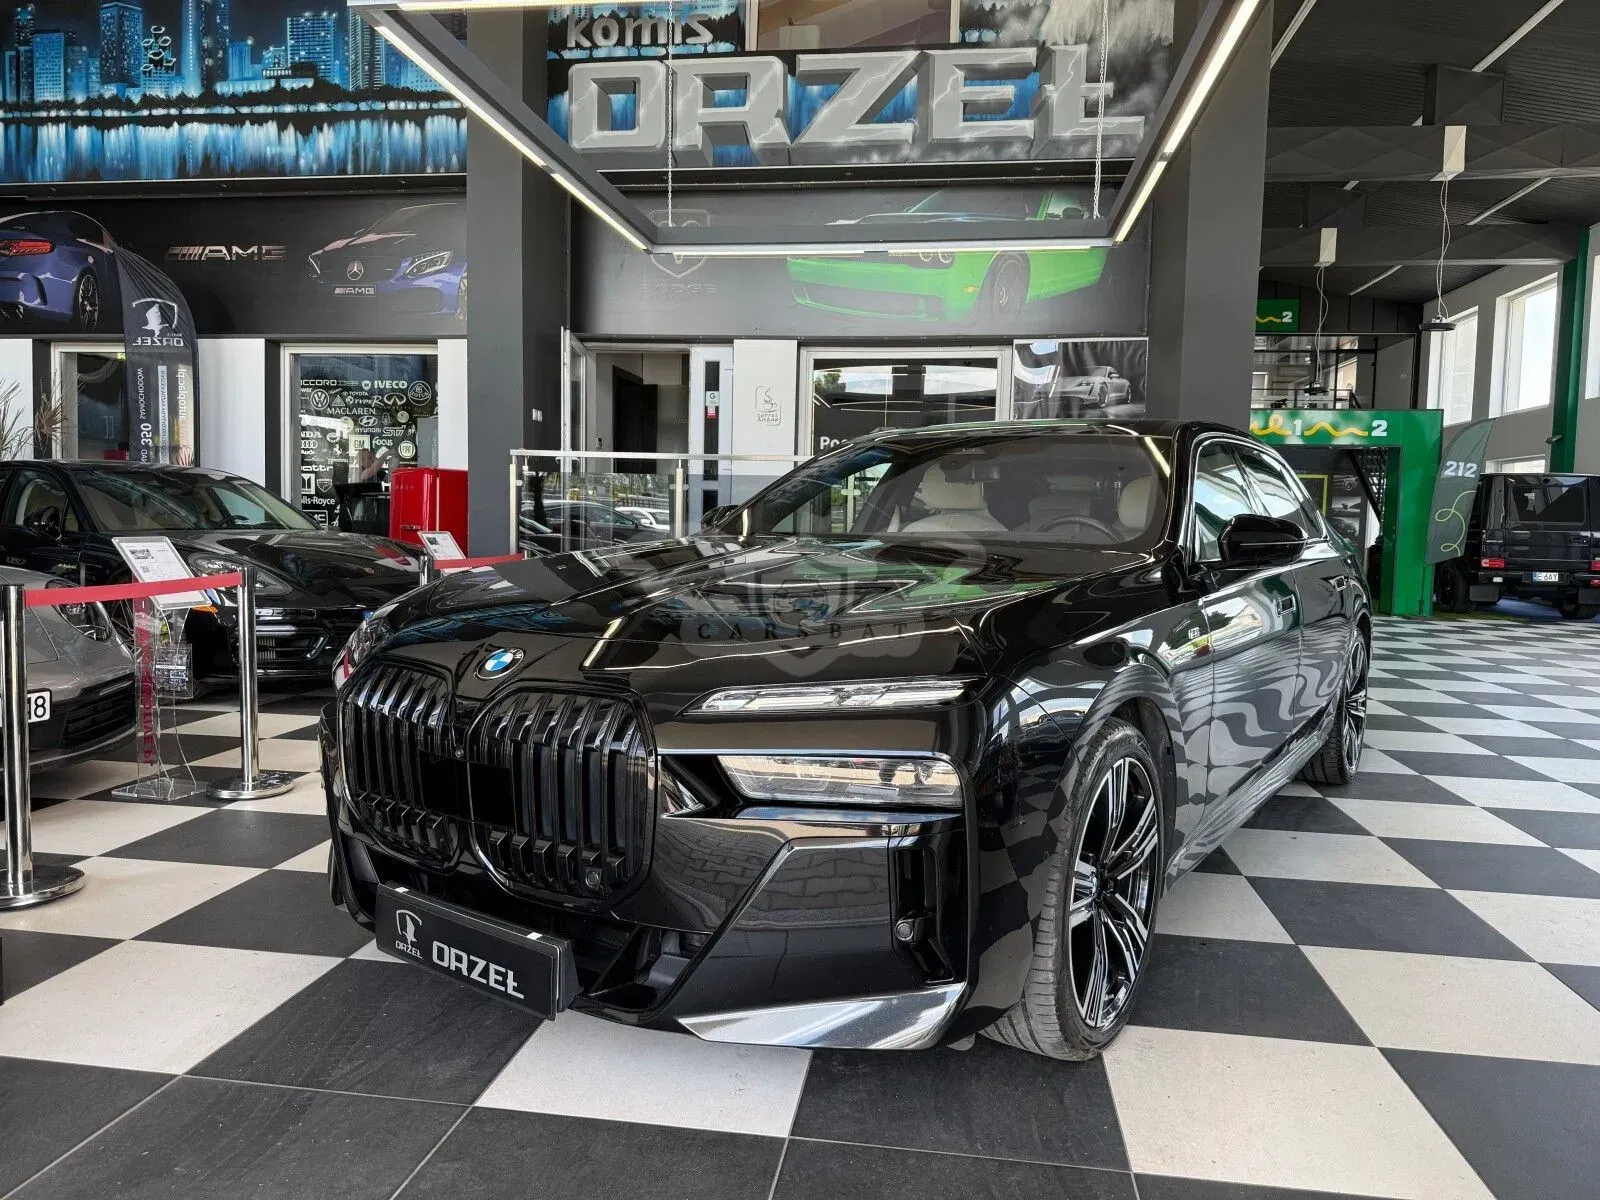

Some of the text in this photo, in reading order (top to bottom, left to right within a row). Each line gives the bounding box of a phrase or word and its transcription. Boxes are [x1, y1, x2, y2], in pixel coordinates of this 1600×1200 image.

[567, 13, 714, 48] komis
[567, 43, 1146, 164] ORZEŁ
[345, 287, 375, 295] AMG
[1282, 311, 1293, 323] 2
[374, 380, 408, 389] IVECO
[326, 407, 377, 415] MACLAREN
[1371, 419, 1388, 437] 2
[1443, 460, 1478, 478] 212
[395, 940, 423, 959] ORZEŁ
[432, 940, 525, 1000] ORZEŁ
